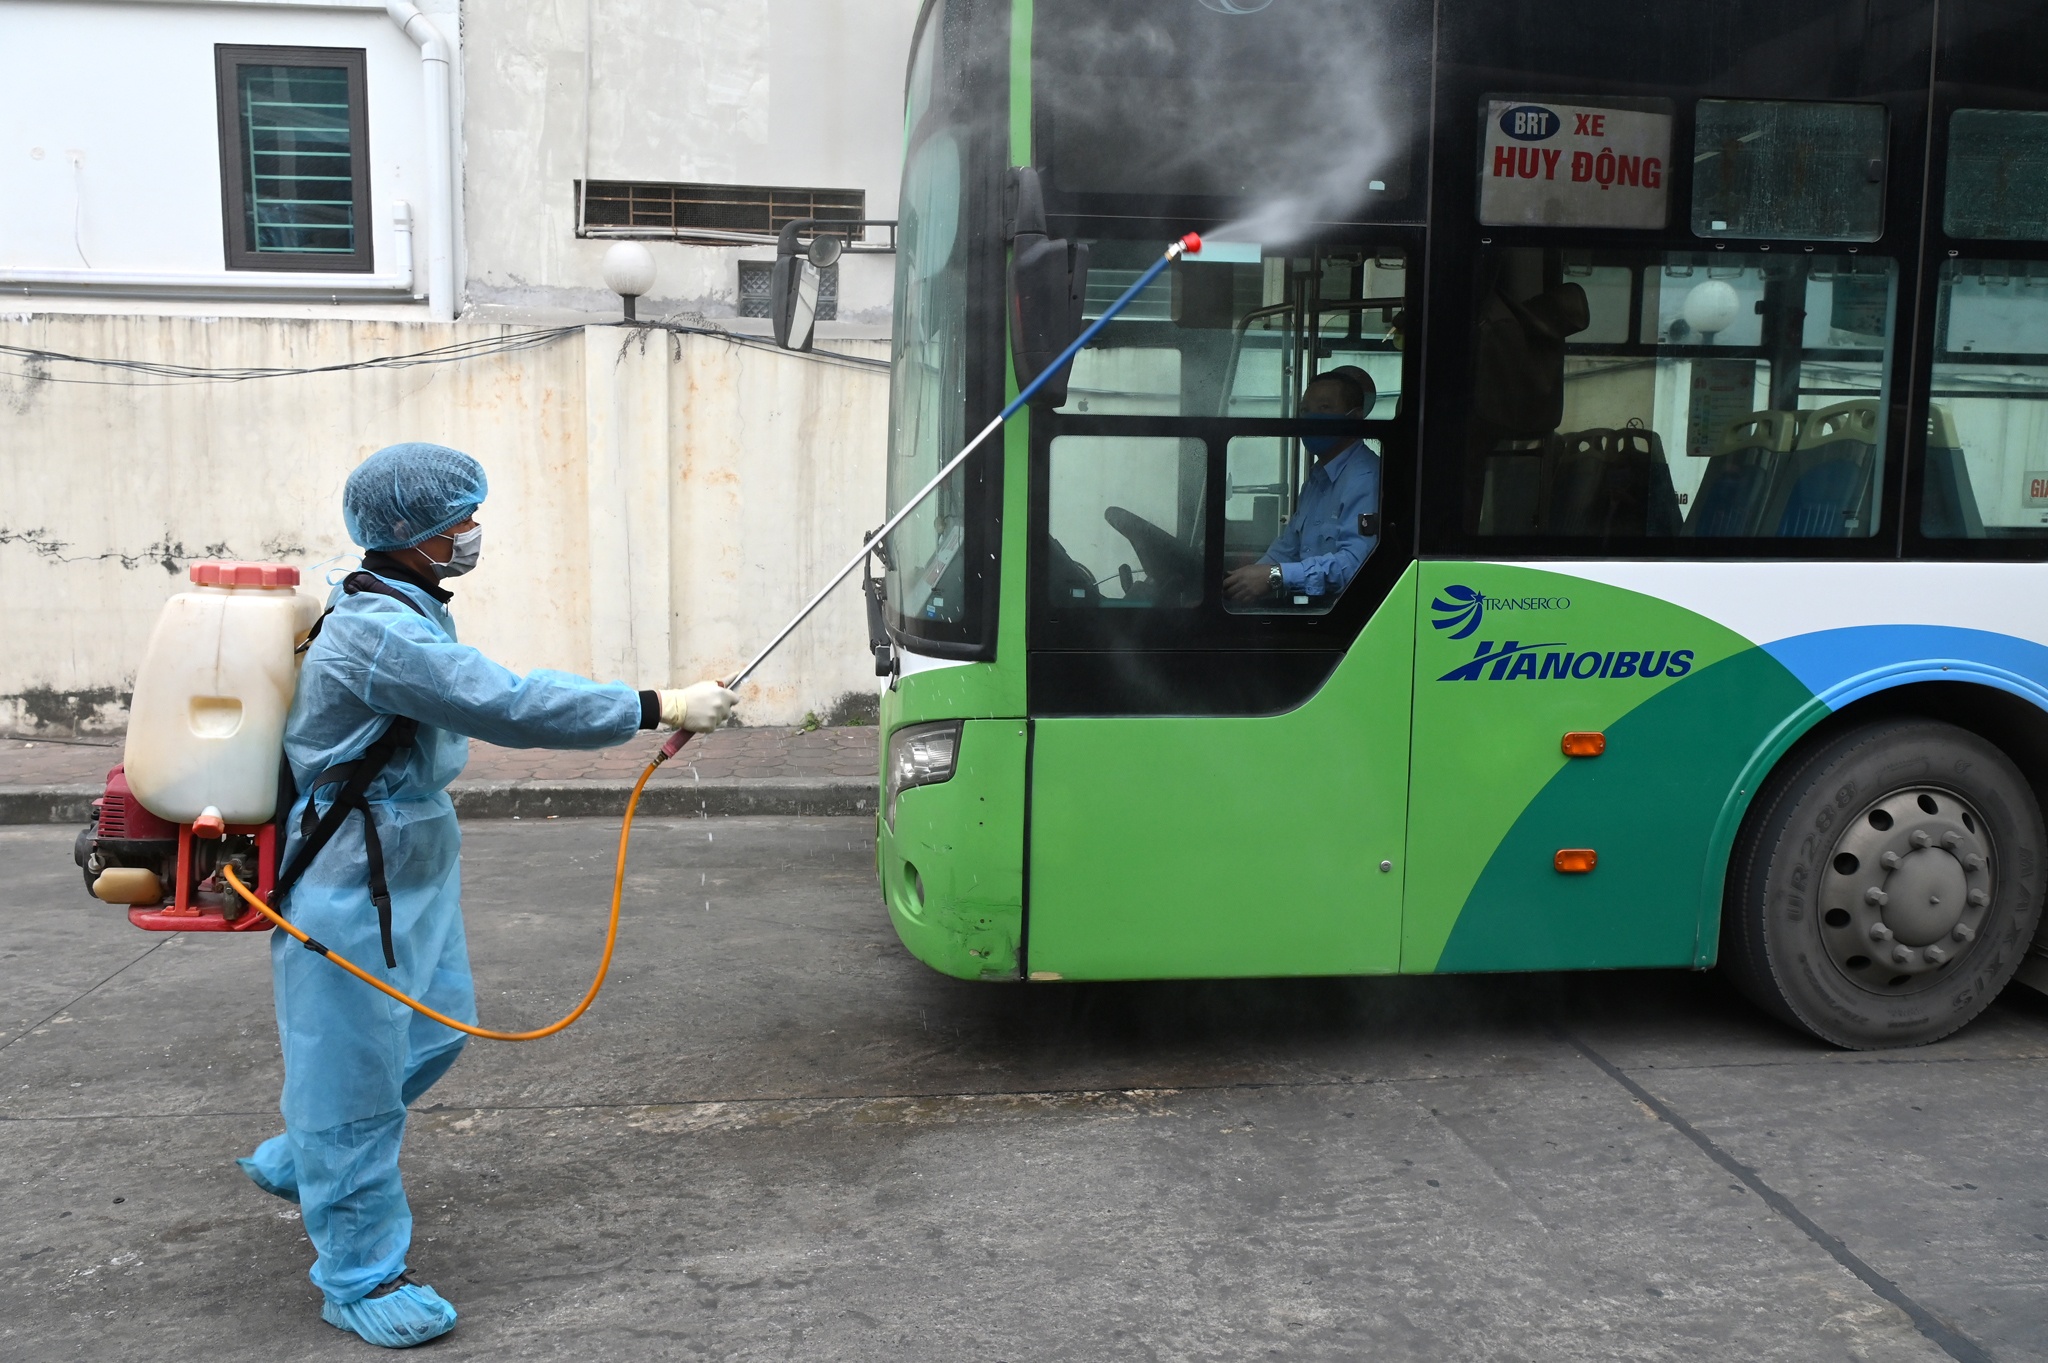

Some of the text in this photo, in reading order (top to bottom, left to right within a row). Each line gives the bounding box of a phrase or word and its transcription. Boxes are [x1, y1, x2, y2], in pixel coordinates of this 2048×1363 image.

[1514, 112, 1606, 137] BRT XE
[1493, 145, 1662, 190] HUY ĐỘNG
[1482, 597, 1571, 611] TRANSERCO
[1436, 641, 1694, 681] HANOIBUS
[1786, 780, 1857, 924] UR288
[1952, 846, 2036, 1013] MAXXIS
